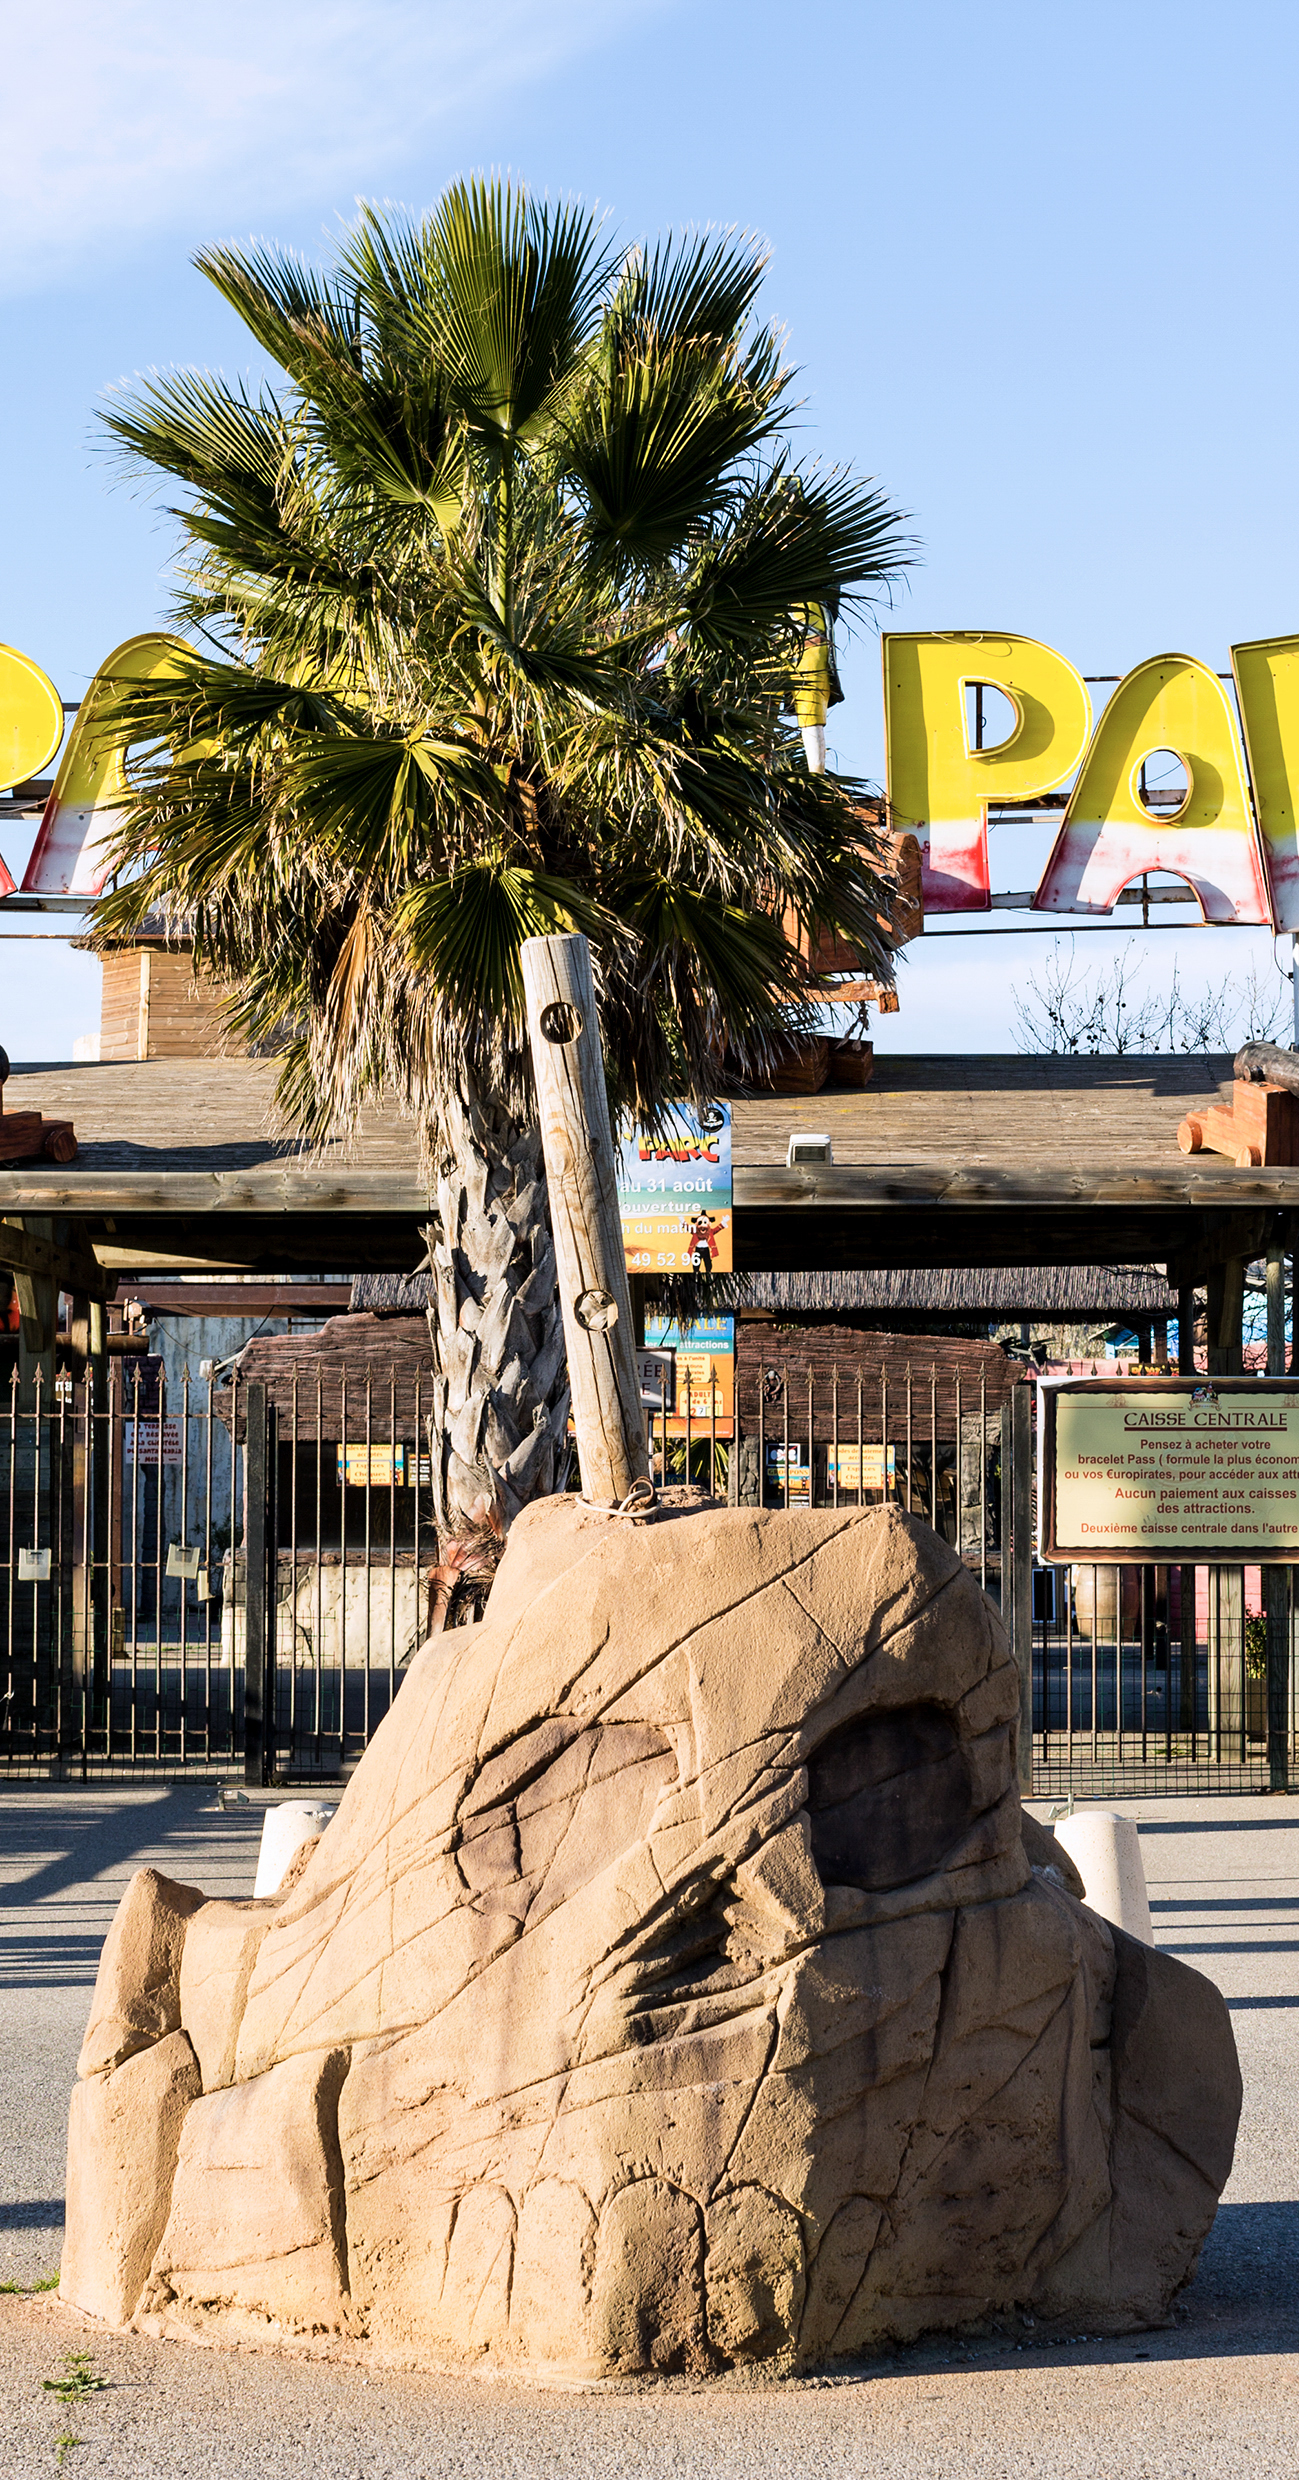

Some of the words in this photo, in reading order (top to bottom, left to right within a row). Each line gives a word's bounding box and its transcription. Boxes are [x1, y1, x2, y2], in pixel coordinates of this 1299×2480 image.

[620, 1180, 641, 1193] au
[646, 1179, 666, 1193] 31
[673, 1178, 713, 1193] août
[634, 1222, 653, 1234] du
[657, 1222, 698, 1234] matin
[631, 1252, 651, 1267] 49
[657, 1252, 676, 1267] 52
[681, 1252, 701, 1267] 96
[679, 1340, 729, 1350] attractions
[1123, 1412, 1186, 1426] CAISSE
[1194, 1412, 1288, 1426] CENTRALE
[1140, 1439, 1182, 1450] Pensez
[1185, 1439, 1192, 1450] à
[1195, 1439, 1238, 1450] acheter
[1241, 1440, 1271, 1450] votre
[1078, 1454, 1124, 1464] bracelet
[1127, 1454, 1155, 1464] Pass
[1166, 1454, 1211, 1464] formule
[1213, 1454, 1224, 1464] la
[1227, 1454, 1252, 1467] plus
[1064, 1471, 1079, 1479] ou
[1083, 1471, 1103, 1479] vos
[1179, 1471, 1206, 1482] pour
[1209, 1469, 1255, 1480] accéder
[1258, 1471, 1279, 1480] aux
[1115, 1488, 1156, 1499] Aucun
[1160, 1488, 1219, 1501] paiement
[1222, 1490, 1245, 1499] aux
[1249, 1488, 1297, 1499] caisses
[1156, 1503, 1180, 1513] des
[1183, 1503, 1255, 1514] attractions.
[1081, 1523, 1138, 1534] Deuxième
[1141, 1523, 1178, 1534] caisse
[1181, 1523, 1228, 1534] centrale
[1231, 1523, 1259, 1534] dans
[1262, 1523, 1298, 1534] l'autre
